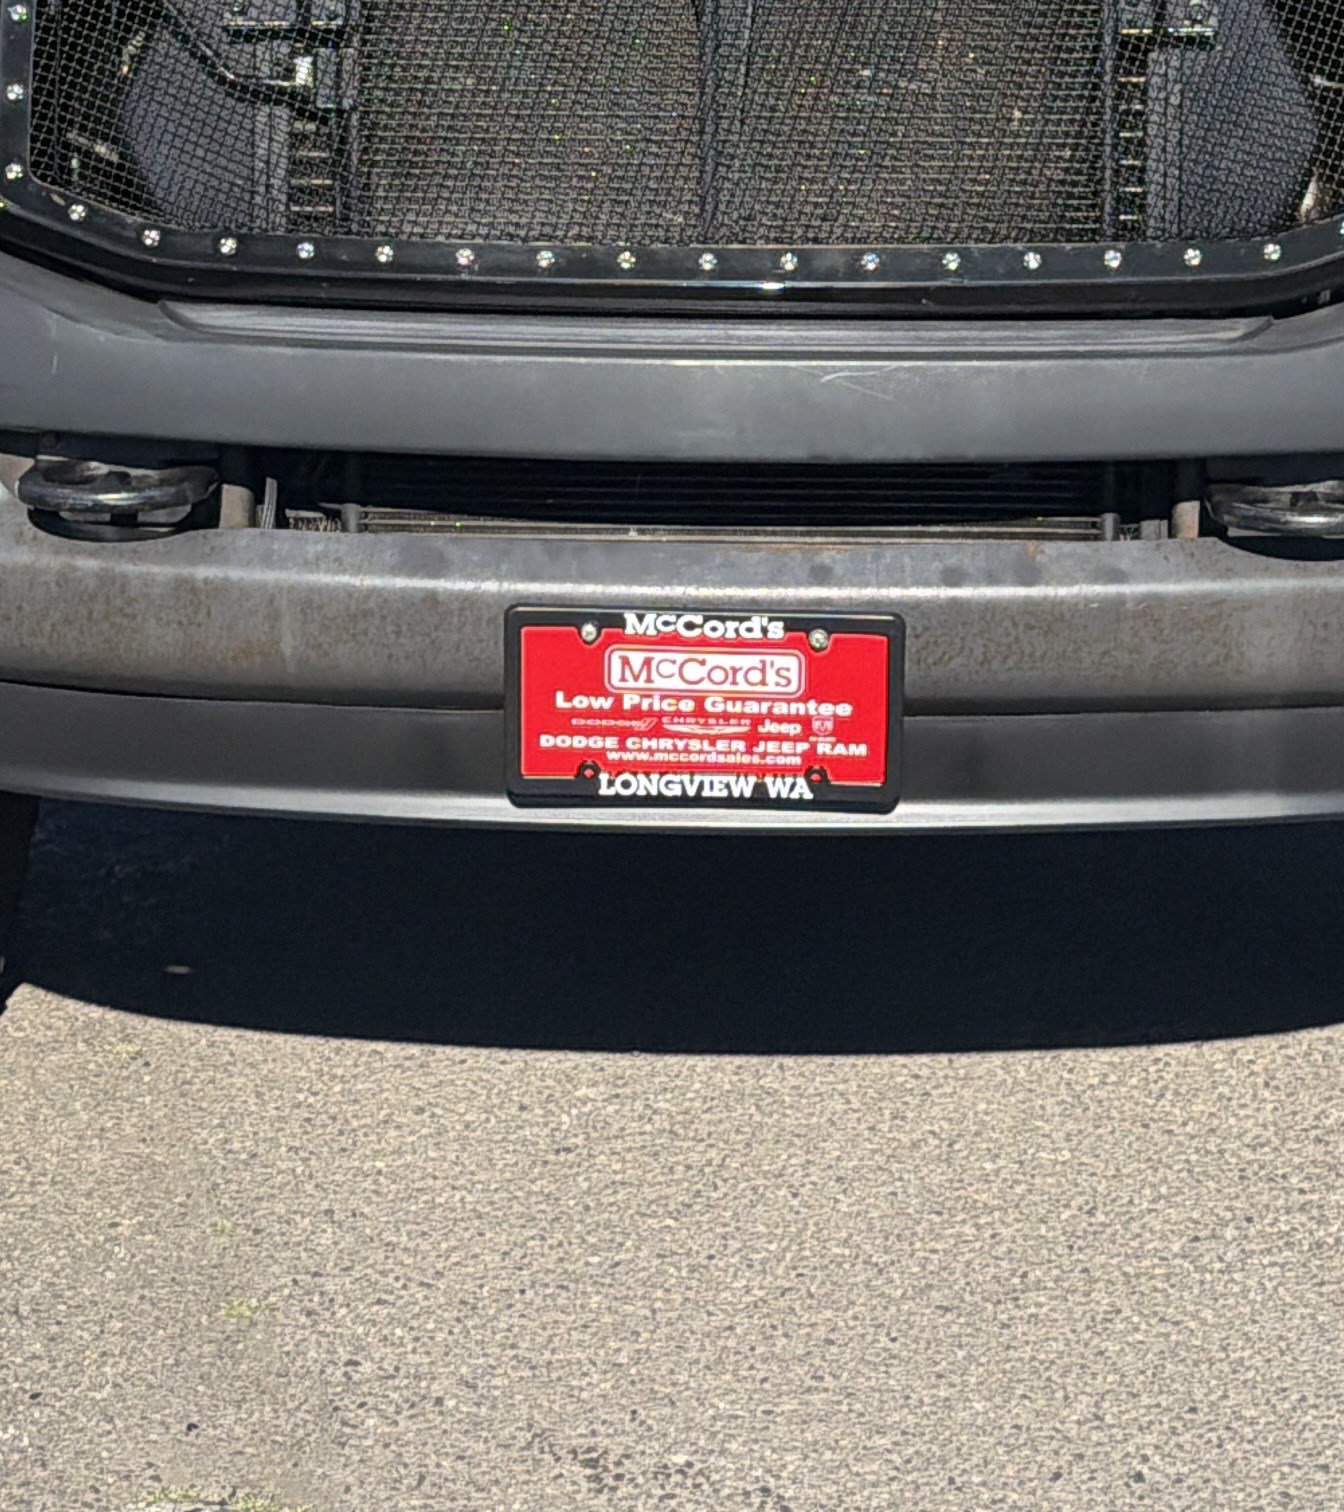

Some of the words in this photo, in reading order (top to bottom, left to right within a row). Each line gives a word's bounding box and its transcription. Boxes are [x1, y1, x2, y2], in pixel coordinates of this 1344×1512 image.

[623, 612, 785, 640] McCord's
[618, 655, 792, 688] McCord's
[555, 691, 615, 710] Low
[622, 694, 696, 713] Price
[704, 696, 854, 717] Guarantee
[757, 718, 803, 736] Jeep
[539, 734, 621, 749] DODGE
[625, 736, 747, 753] CHRYSLER
[752, 740, 811, 755] JEEP
[816, 743, 868, 757] RAM
[607, 751, 802, 766] www.mccordsales.com
[598, 772, 756, 798] LONGVIEW
[764, 775, 814, 800] WA
